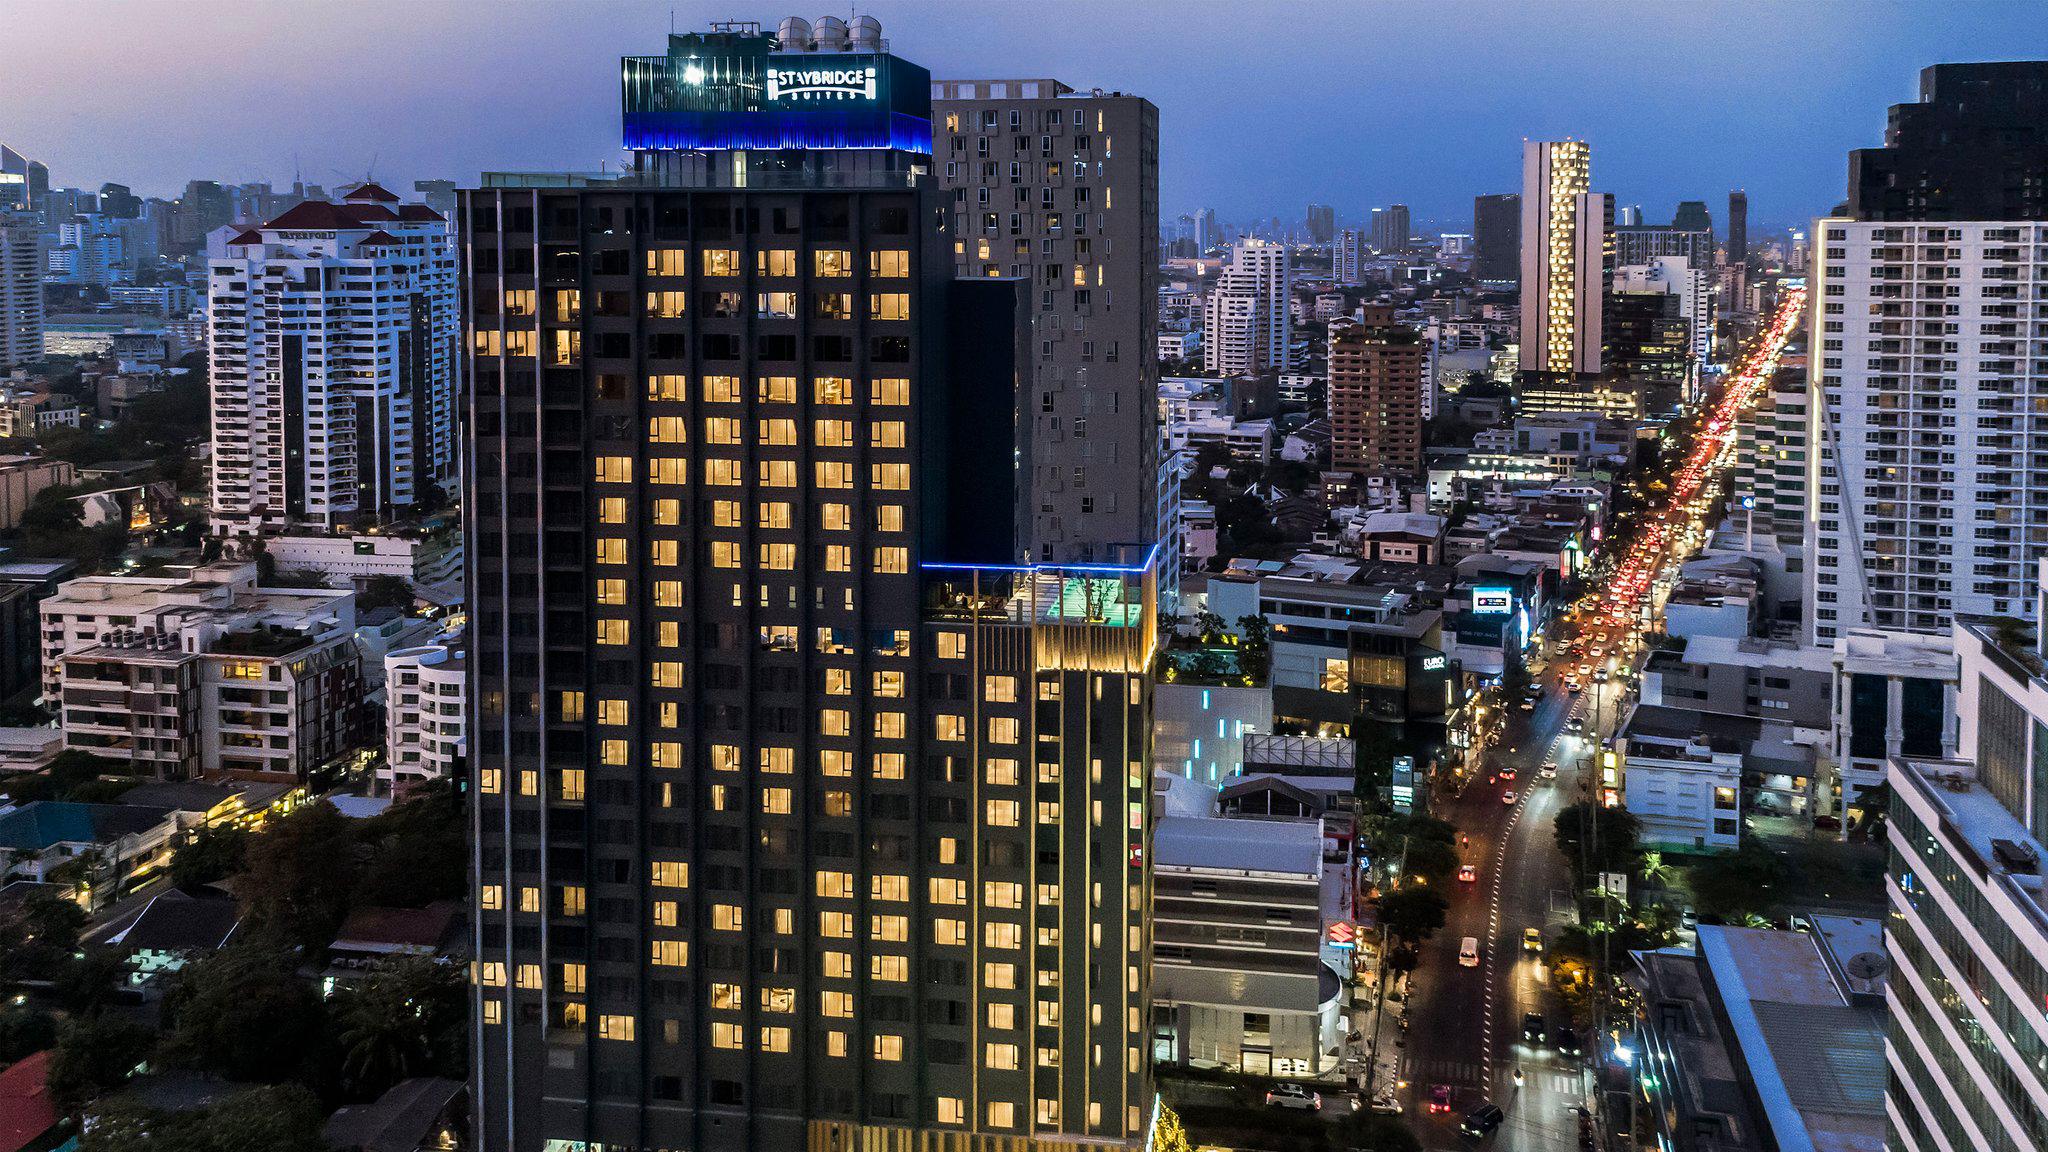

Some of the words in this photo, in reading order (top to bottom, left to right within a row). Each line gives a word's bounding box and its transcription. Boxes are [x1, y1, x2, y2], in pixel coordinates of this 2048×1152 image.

[778, 70, 864, 85] STAYBRIDGE
[791, 91, 856, 100] SUITES
[278, 231, 336, 239] WATERFORD
